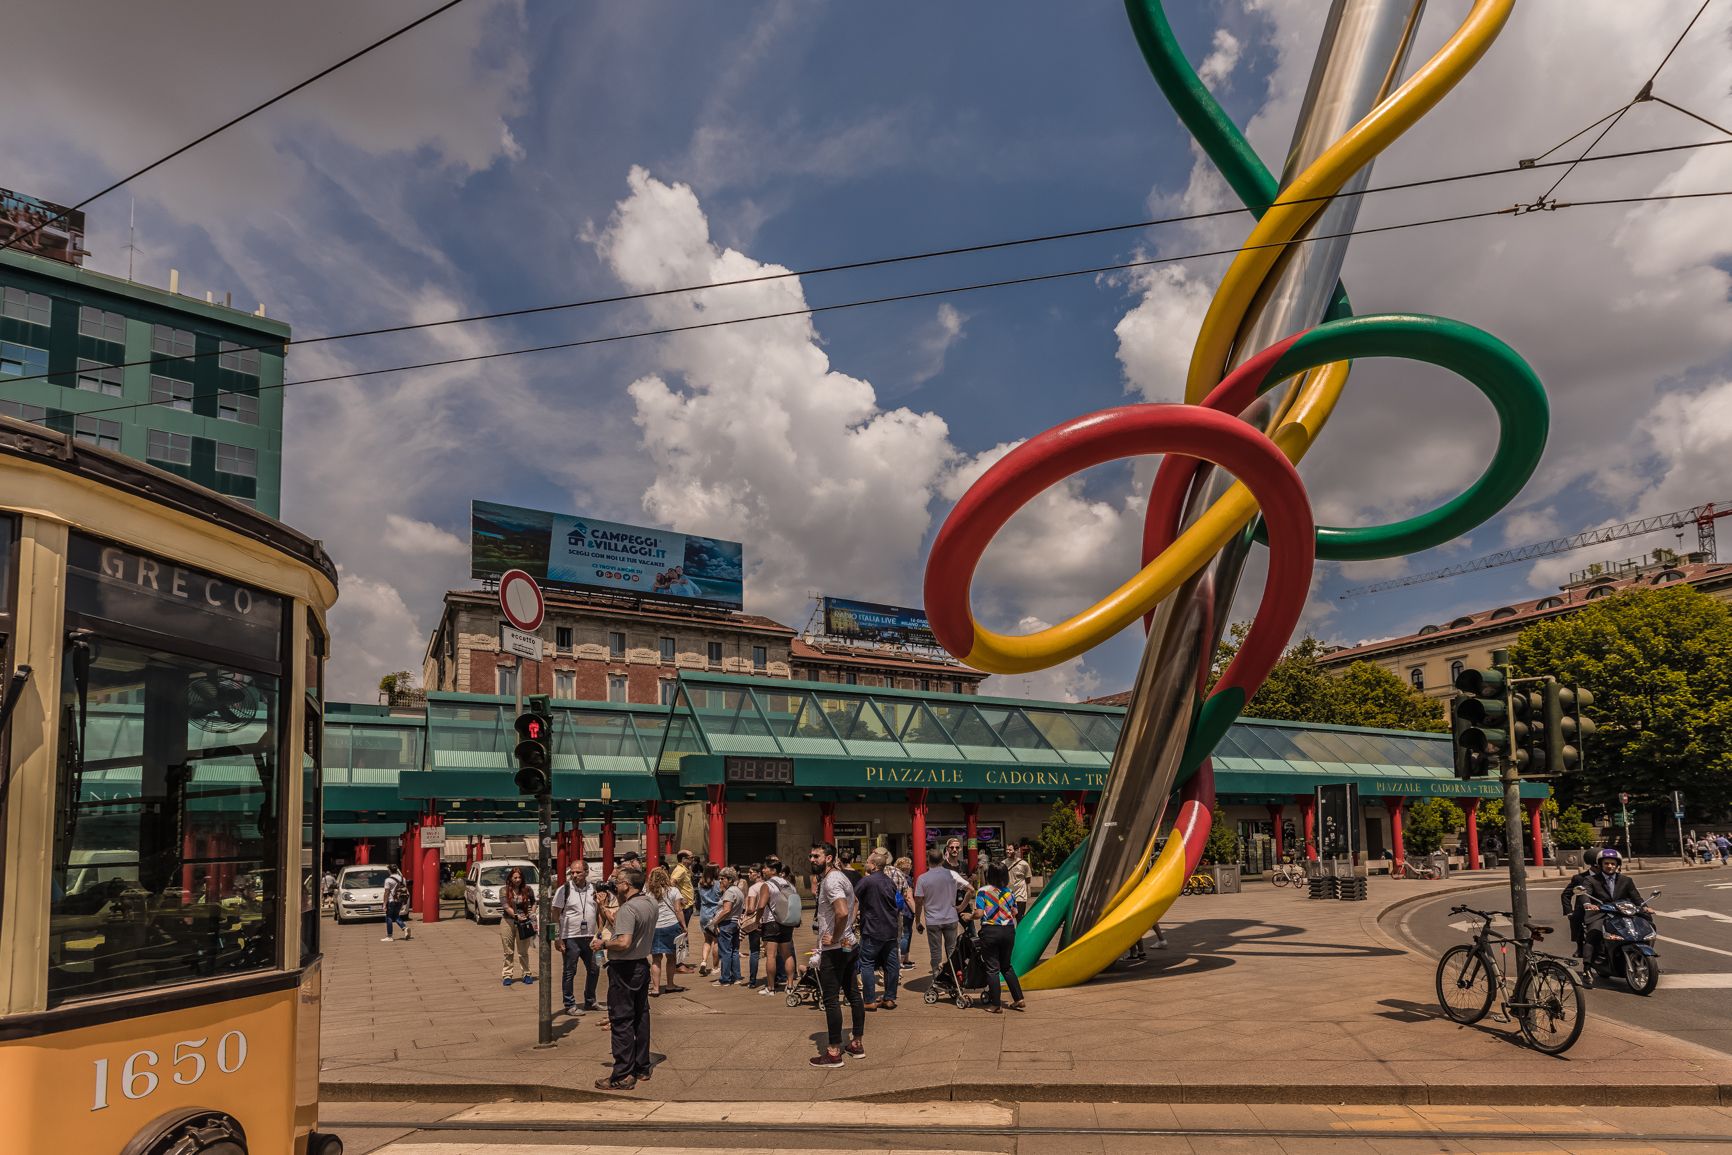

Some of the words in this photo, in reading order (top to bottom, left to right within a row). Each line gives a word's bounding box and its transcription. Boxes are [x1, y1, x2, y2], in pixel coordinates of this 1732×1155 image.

[591, 529, 658, 548] CAMPEGGI
[568, 549, 590, 557] SCEGLI
[591, 551, 605, 559] CON
[606, 553, 617, 561] NOI
[638, 559, 665, 568] VACANZE
[587, 540, 667, 559] &VILLAGGI.IT
[101, 547, 252, 615] GRECO
[859, 614, 880, 623] ITALIA
[881, 617, 897, 625] LIVE
[511, 632, 536, 645] eccetto
[866, 766, 964, 783] PIAZZALE
[986, 770, 1070, 786] CADORNA
[1376, 781, 1421, 792] PIAZZALE
[1431, 783, 1472, 793] CADORNA
[90, 1030, 248, 1112] 1650
